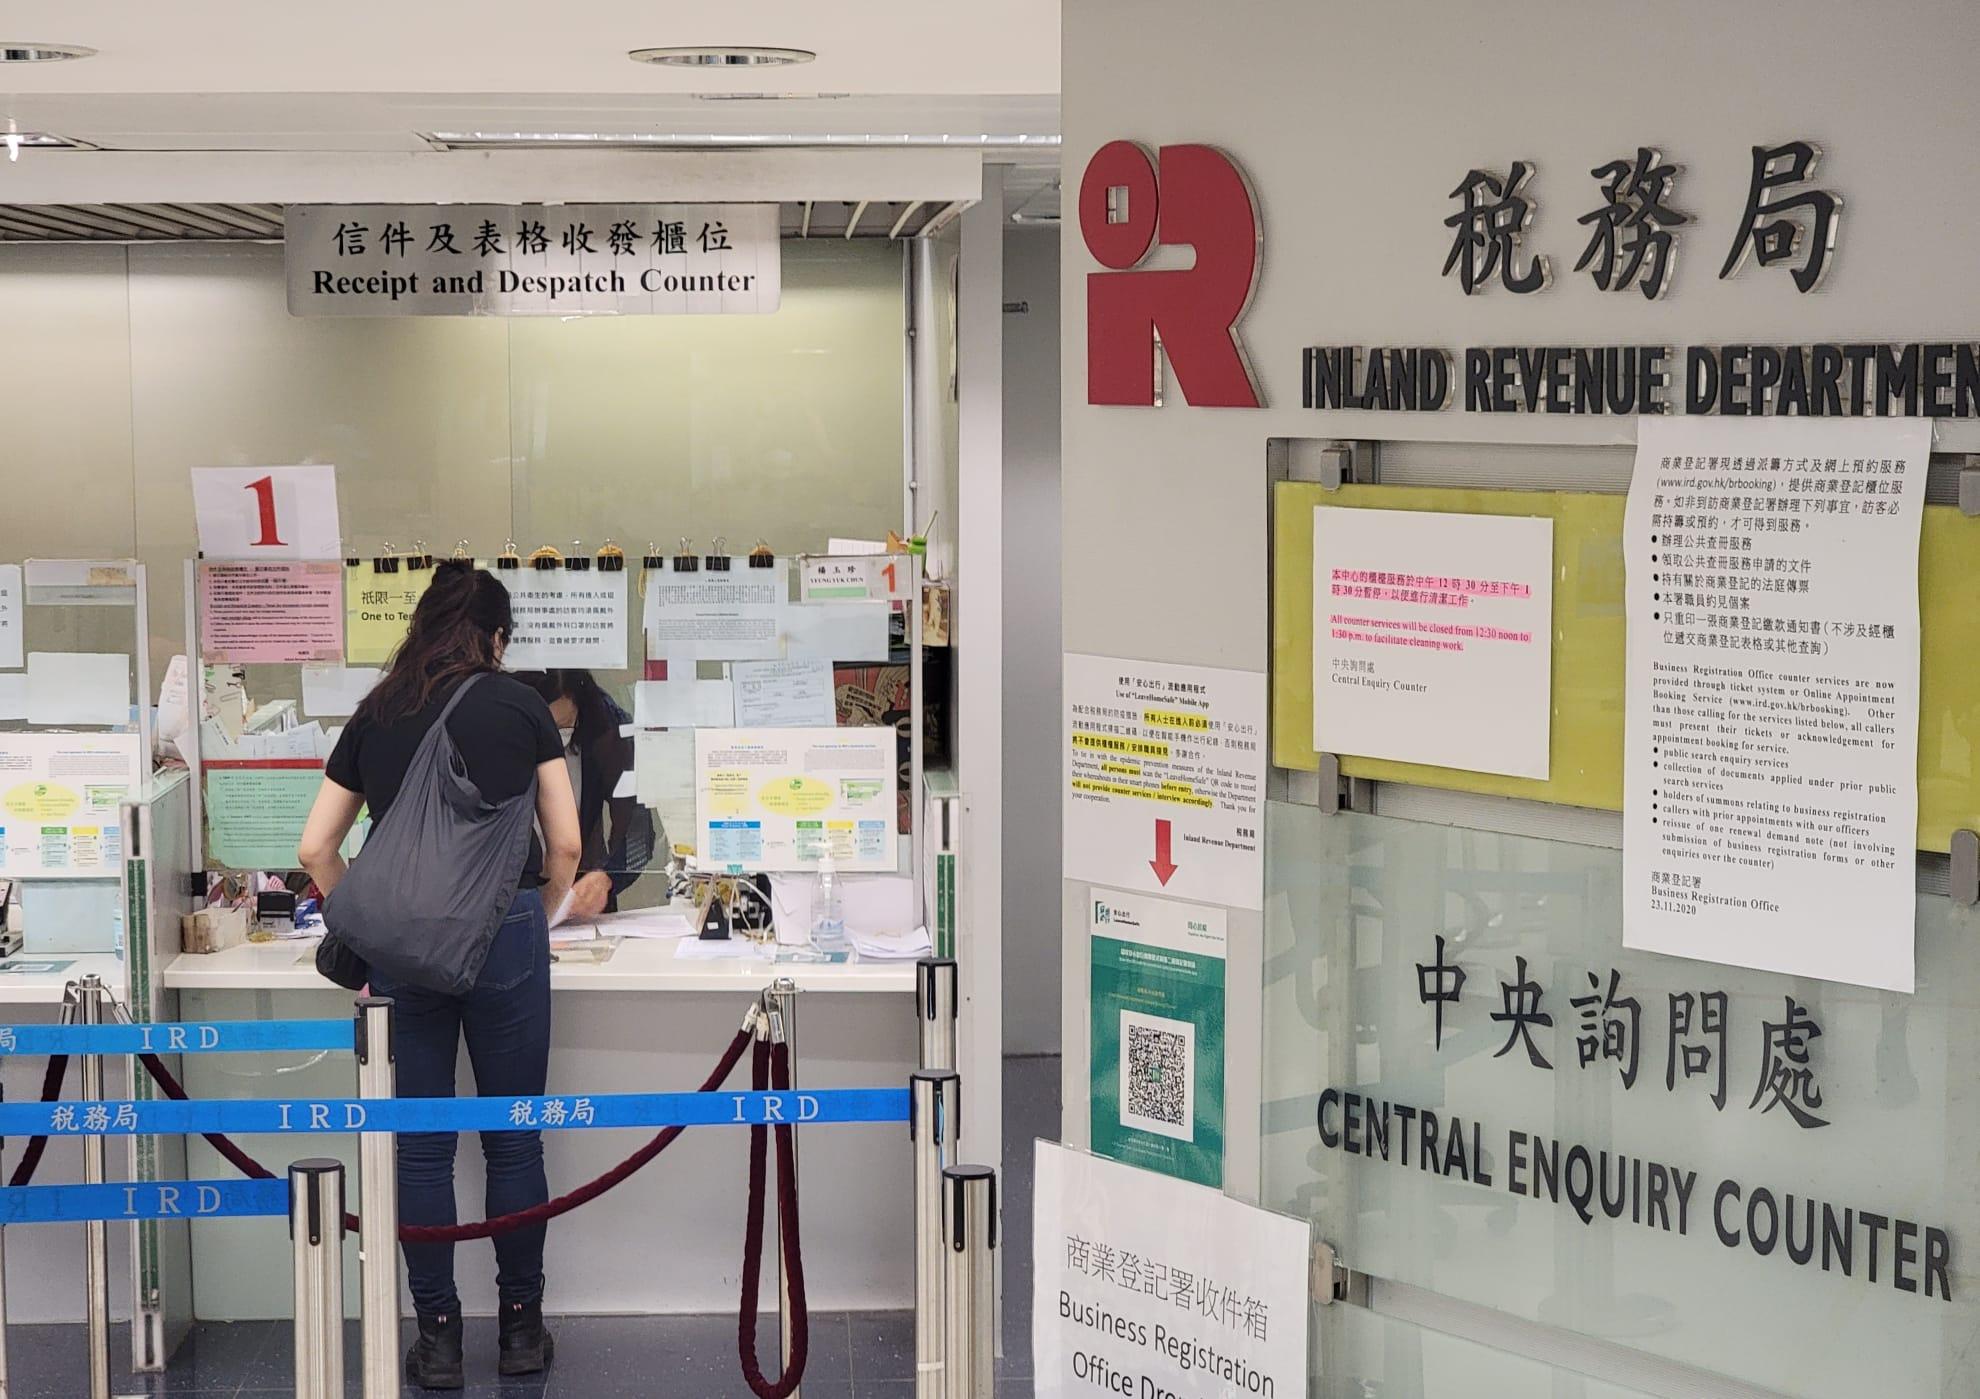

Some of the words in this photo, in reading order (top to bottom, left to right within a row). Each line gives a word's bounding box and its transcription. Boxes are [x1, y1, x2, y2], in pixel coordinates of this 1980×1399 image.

[332, 220, 734, 258] 信件及表格收發櫃位
[313, 270, 419, 300] Receipt
[433, 270, 484, 294] and
[501, 270, 625, 299] Despatch
[641, 269, 755, 293] Counter
[1302, 347, 1452, 409] INLAND
[1466, 347, 1668, 412] REVENUE
[245, 476, 288, 545] 1
[881, 563, 896, 593] 1
[1343, 586, 1352, 595] 30
[1439, 578, 1448, 588] 12
[1466, 581, 1476, 590] 30
[1480, 581, 1520, 595] 分至下午
[362, 612, 381, 621] One
[385, 613, 395, 621] to
[1332, 615, 1342, 625] All
[1344, 617, 1370, 626] counter
[1371, 619, 1401, 629] services
[1402, 620, 1417, 630] will
[1419, 622, 1428, 631] be
[1430, 622, 1454, 634] closed
[1455, 624, 1473, 637] from
[1476, 626, 1496, 639] 12:30
[1498, 632, 1518, 641] noon
[1520, 633, 1529, 642] to
[1332, 629, 1347, 639] 1:30
[1349, 632, 1363, 642] p.m.
[1365, 634, 1372, 642] to
[1374, 633, 1407, 646] facilitate
[1409, 639, 1440, 650] cleaning
[1442, 640, 1464, 651] work.
[1331, 673, 1360, 685] Central
[1361, 676, 1390, 692] Enquiry
[1393, 680, 1428, 693] Counter
[1653, 661, 1688, 673] Business
[1693, 665, 1743, 678] Registration
[1748, 669, 1774, 680] Office
[1778, 674, 1811, 683] counter
[1815, 676, 1850, 687] services
[1855, 680, 1870, 688] are
[1875, 681, 1895, 689] now
[1653, 677, 1689, 687] provided
[1693, 679, 1726, 692] through
[1730, 682, 1754, 693] ticket
[1757, 686, 1786, 696] system
[1790, 689, 1800, 697] or
[1803, 688, 1832, 700] Online
[1836, 692, 1895, 704] Appointment
[1653, 689, 1687, 703] Booking
[1692, 693, 1723, 704] Service
[1867, 708, 1896, 720] Other
[1653, 704, 1671, 714] than
[1674, 706, 1695, 717] those
[1697, 708, 1726, 721] calling
[1728, 710, 1741, 721] for
[1743, 712, 1757, 722] the
[1759, 714, 1793, 725] services
[1795, 716, 1819, 728] listed
[1821, 719, 1849, 731] below,
[1851, 721, 1863, 732] all
[1865, 723, 1896, 735] callers
[1652, 720, 1672, 729] must
[1679, 722, 1710, 732] present
[1717, 724, 1738, 735] their
[1744, 727, 1773, 738] tickets
[1780, 732, 1791, 740] or
[1797, 733, 1874, 748] acknowledgement
[1881, 739, 1896, 750] for
[1652, 734, 1704, 746] appointment
[1706, 737, 1739, 751] booking
[1741, 740, 1755, 751] for
[1756, 744, 1790, 754] service.
[1663, 748, 1689, 759] public
[1691, 752, 1717, 762] search
[1719, 755, 1752, 767] enquiry
[1754, 758, 1789, 769] services
[1663, 762, 1702, 774] collection
[1707, 766, 1716, 776] of
[1720, 768, 1765, 781] documents
[1770, 774, 1803, 785] applied
[1808, 778, 1835, 788] under
[1839, 780, 1864, 792] prior
[1868, 784, 1897, 795] public
[1663, 777, 1690, 787] search
[1691, 780, 1724, 791] services
[1662, 804, 1690, 815] callers
[1692, 807, 1711, 818] with
[1713, 810, 1734, 821] prior
[1736, 815, 1793, 828] appointments
[1795, 819, 1815, 830] with
[1817, 824, 1834, 833] our
[1835, 824, 1870, 837] officers
[1202, 836, 1223, 847] Revenue
[1225, 839, 1255, 852] Department
[1651, 885, 1688, 900] Business
[1691, 891, 1748, 908] Registration
[1750, 899, 1780, 913] Office
[1651, 899, 1697, 915] 23.11.2020
[141, 1026, 220, 1050] IRD
[1416, 934, 1831, 1129] 中央詢問處
[278, 1103, 367, 1130] IRD
[732, 1095, 820, 1122] IRD
[123, 1186, 221, 1215] IRD
[1317, 1088, 1492, 1187] CENTRAL
[1507, 1131, 1697, 1235] ENQUIRY
[1713, 1179, 1952, 1302] COUNTER
[1067, 1234, 1268, 1343] 商業登記署收件箱
[1059, 1291, 1147, 1346] Business
[1155, 1325, 1274, 1399] Registration
[1073, 1351, 1133, 1397] Office
